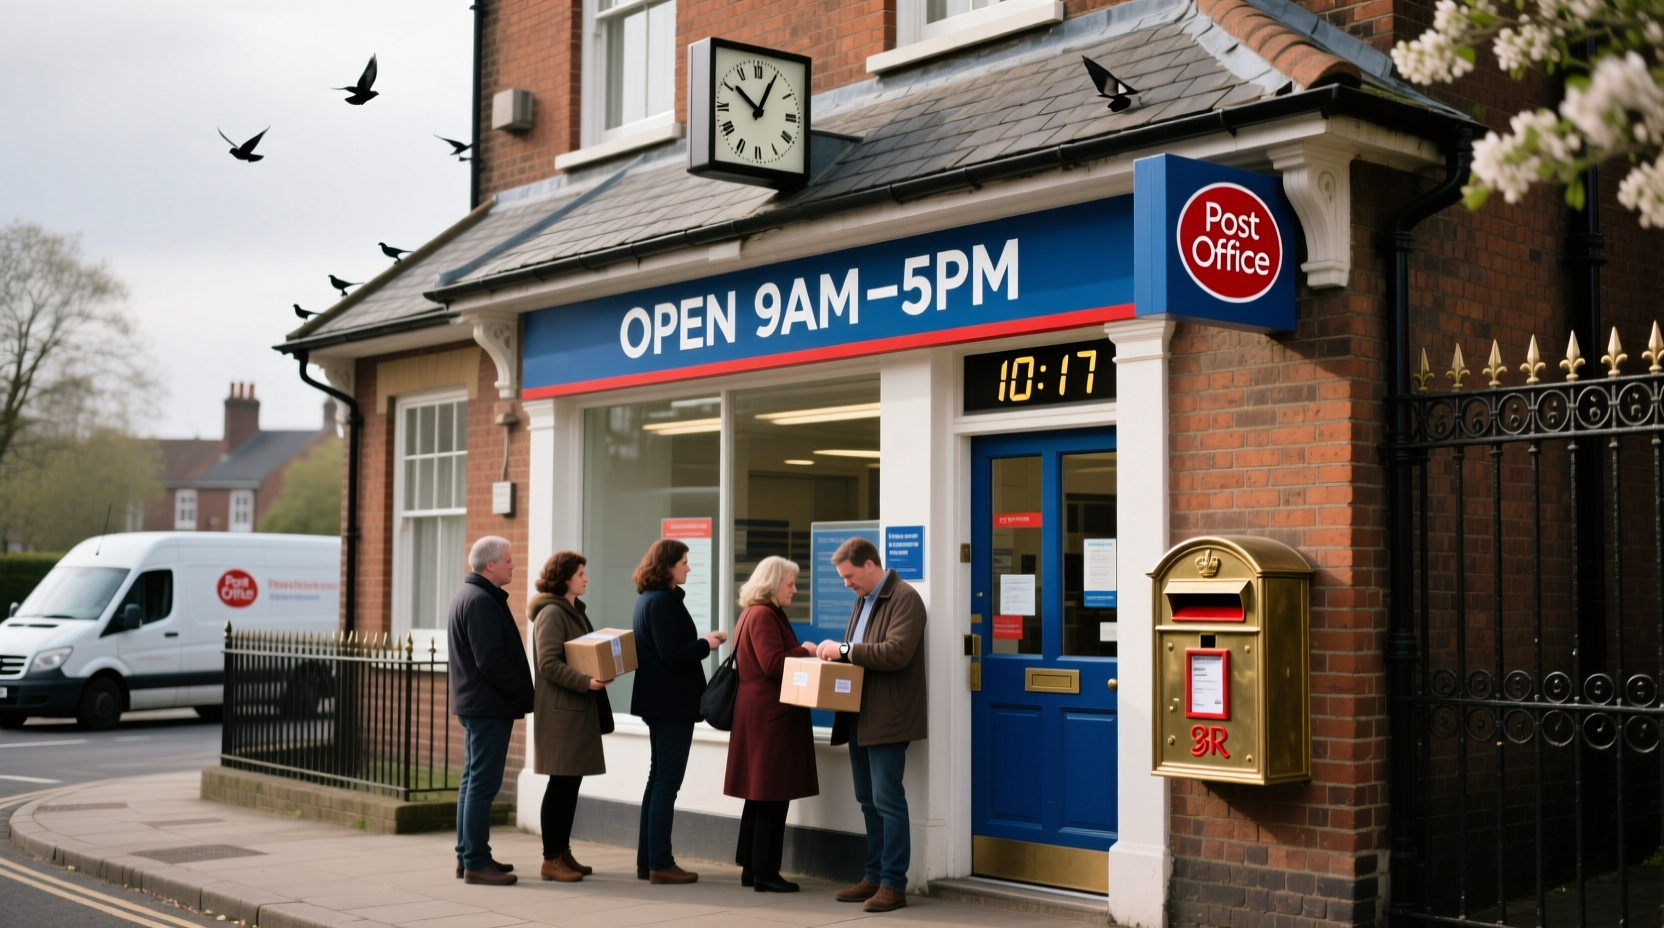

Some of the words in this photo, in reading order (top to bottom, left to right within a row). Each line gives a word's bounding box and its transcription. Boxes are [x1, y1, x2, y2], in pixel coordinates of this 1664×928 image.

[1205, 201, 1260, 241] Post
[1191, 235, 1270, 276] Office
[619, 290, 737, 360] OPEN
[998, 350, 1097, 402] 10:17
